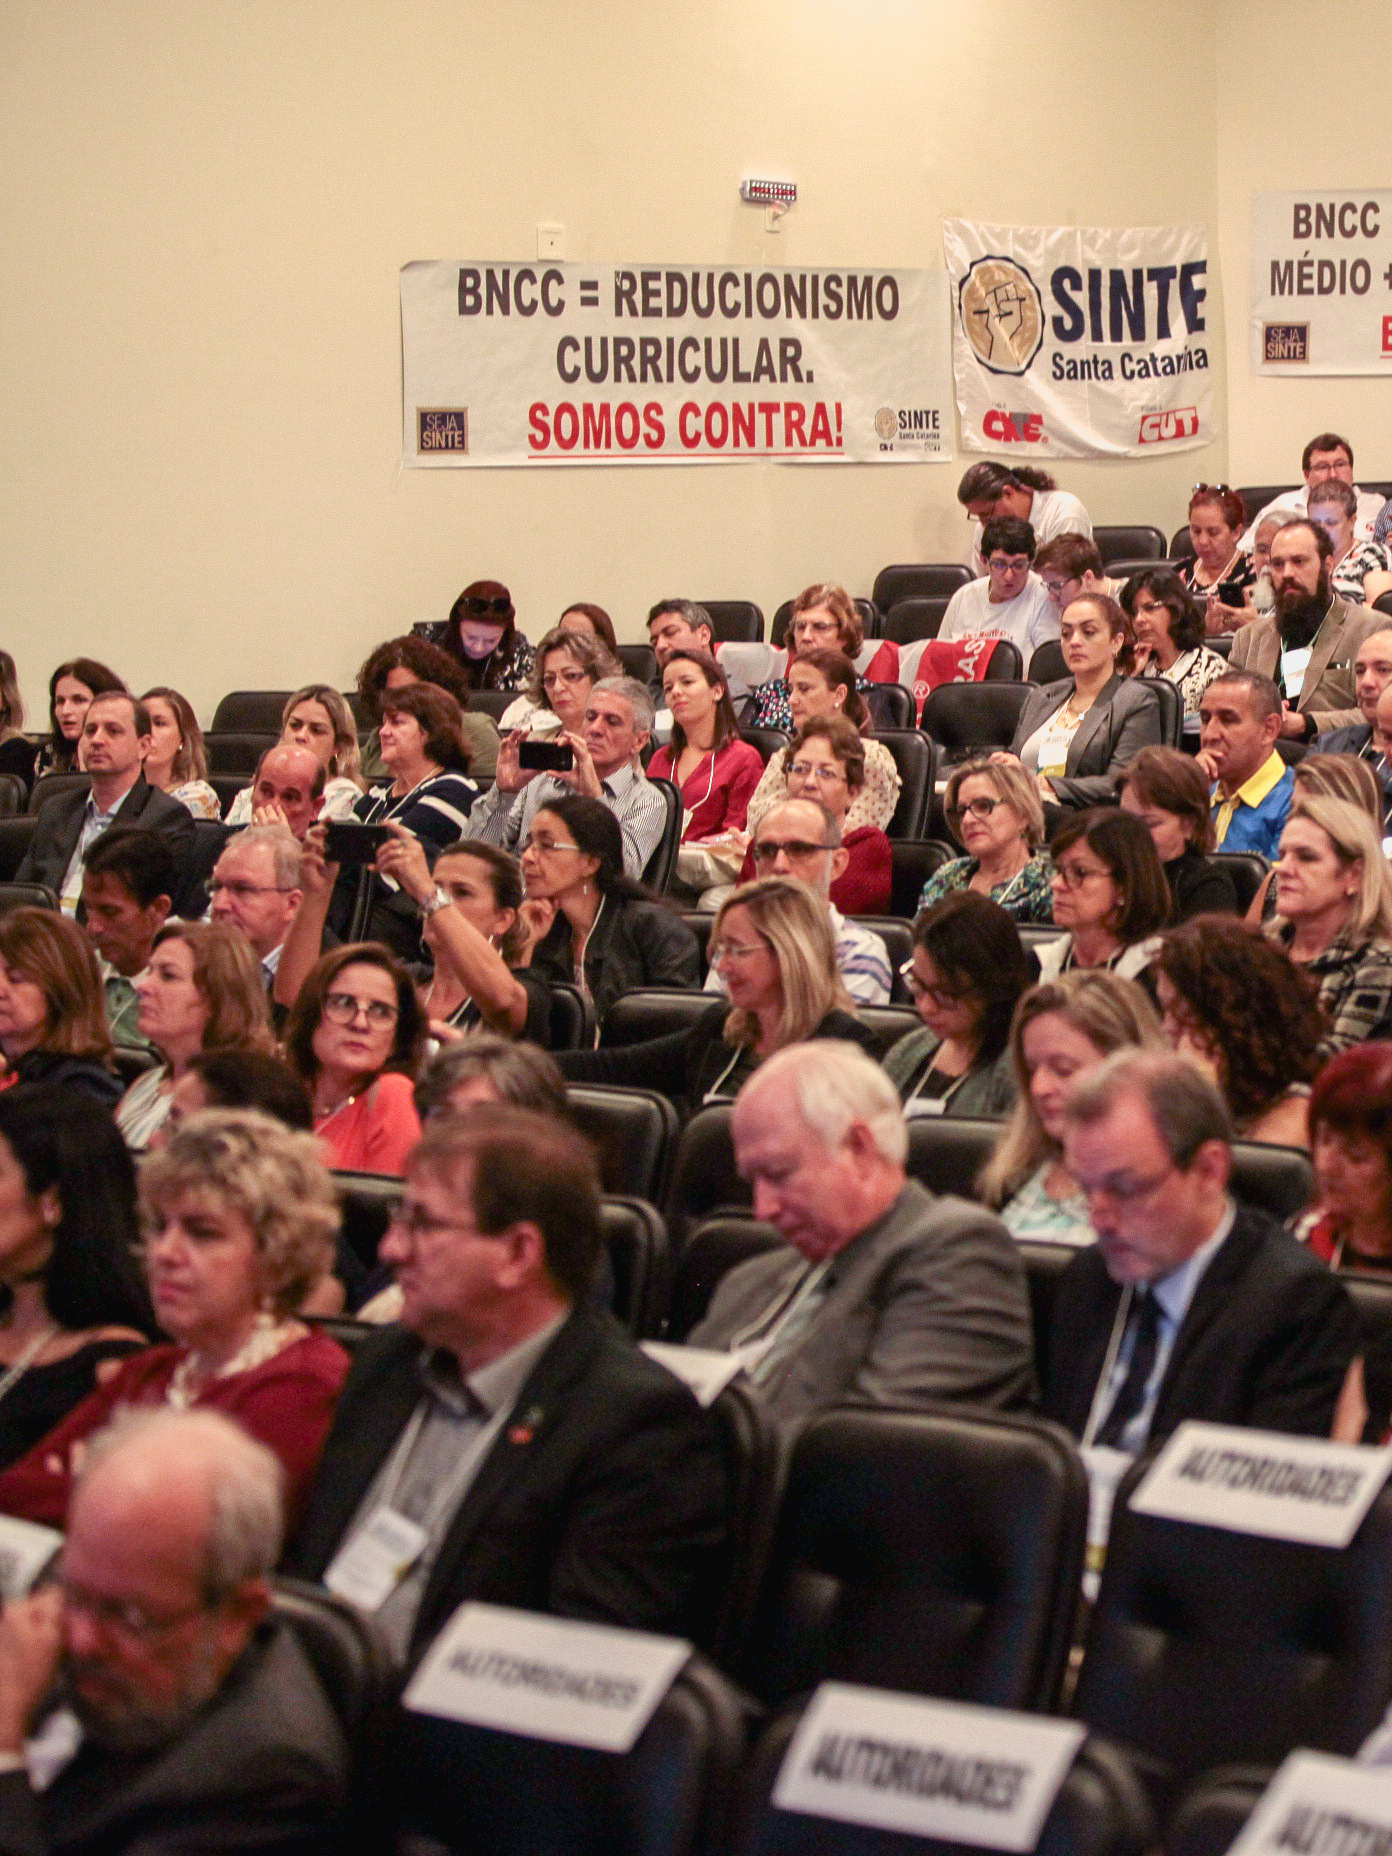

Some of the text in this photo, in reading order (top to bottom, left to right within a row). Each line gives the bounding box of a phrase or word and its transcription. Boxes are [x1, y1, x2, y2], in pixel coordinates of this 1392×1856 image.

[1293, 201, 1380, 239] BNCC
[1270, 250, 1372, 297] MÉDIO
[457, 268, 566, 316] BNCC
[614, 270, 900, 321] REDUCIONISMO
[1051, 260, 1208, 343] SINTE
[556, 336, 814, 384] CURRICULAR.
[1052, 351, 1115, 380] Santa
[1267, 342, 1305, 359] SINTE
[527, 401, 844, 450] SOMOS CONTRA!
[898, 409, 940, 430] SINTE
[1139, 406, 1199, 443] CUT
[422, 430, 463, 449] SINTE
